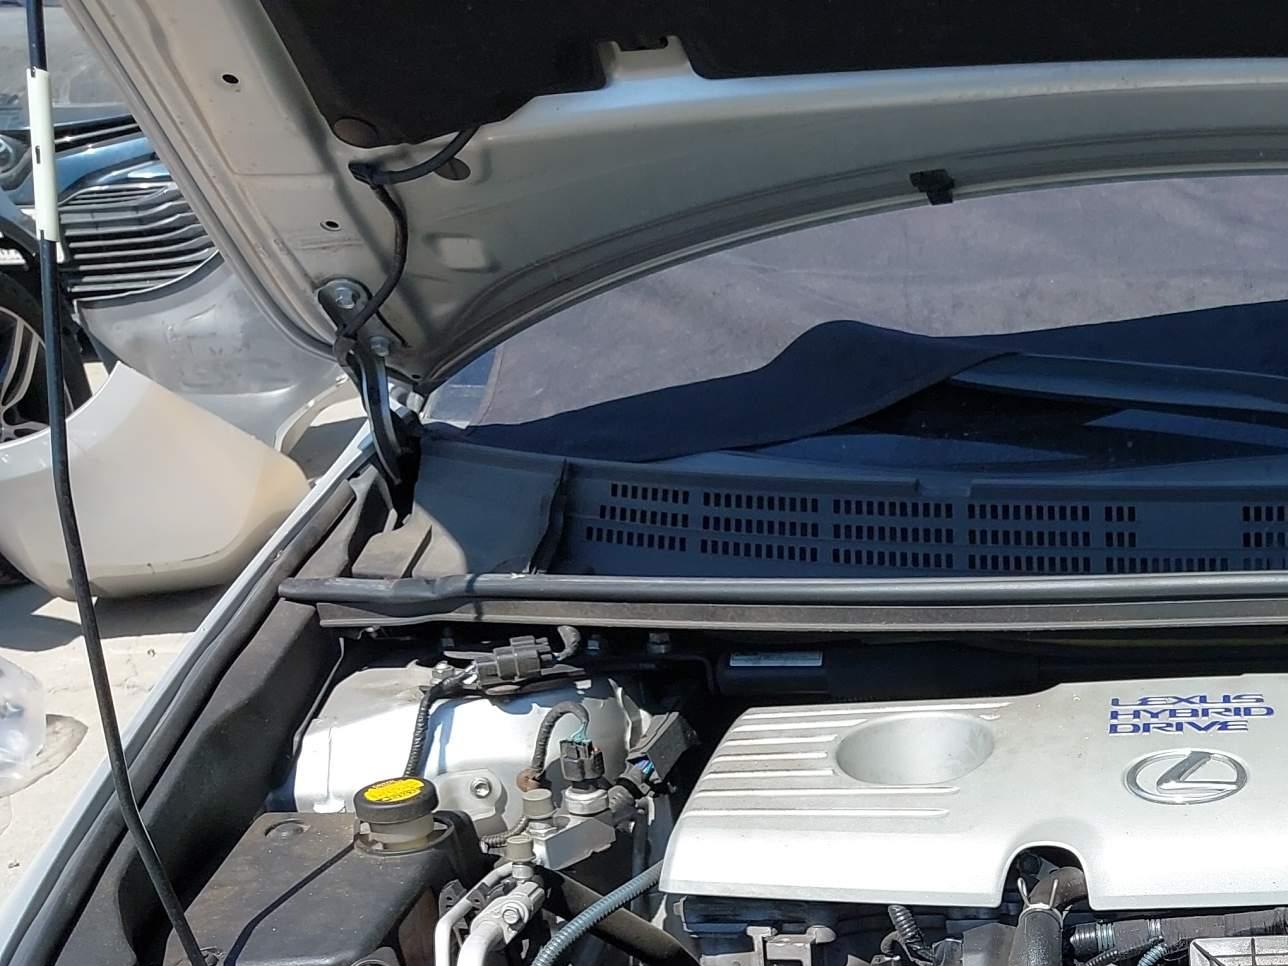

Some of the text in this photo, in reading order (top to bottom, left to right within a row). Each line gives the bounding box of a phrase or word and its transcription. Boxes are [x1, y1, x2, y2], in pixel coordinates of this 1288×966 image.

[1110, 693, 1265, 707] LEXUS
[1110, 706, 1275, 720] HYBRID
[1109, 720, 1249, 734] DRIVE
